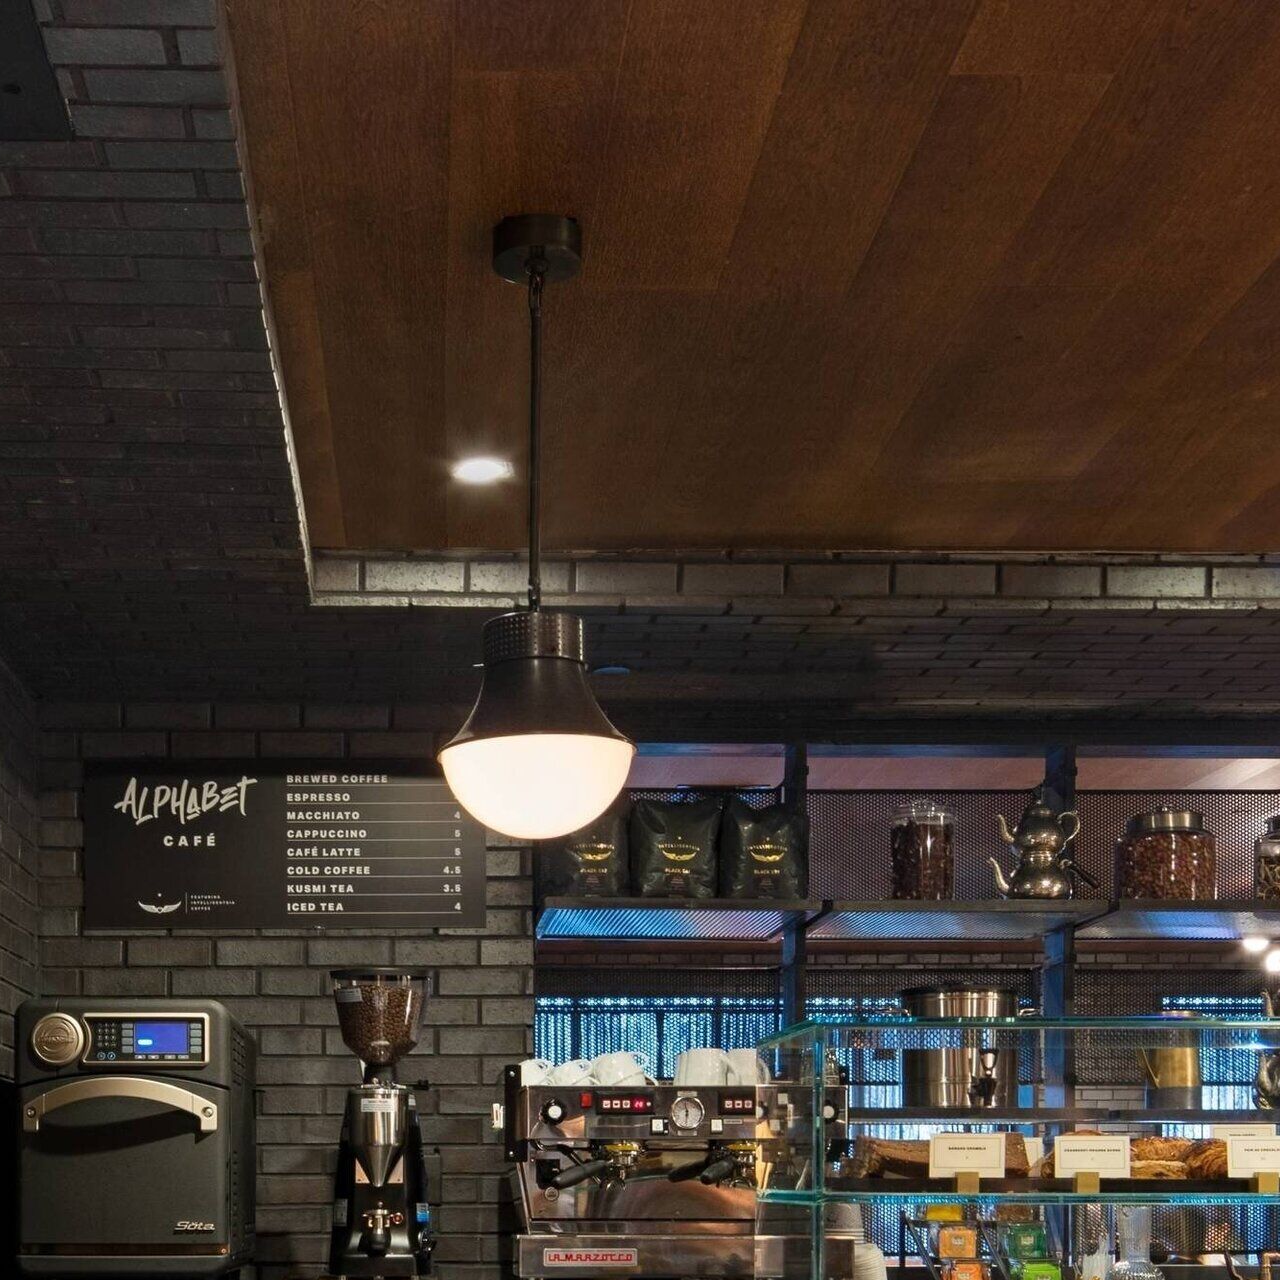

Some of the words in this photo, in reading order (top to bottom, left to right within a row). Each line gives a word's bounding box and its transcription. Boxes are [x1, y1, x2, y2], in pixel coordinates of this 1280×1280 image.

[286, 775, 337, 783] BREWED
[342, 775, 388, 783] COFFEE
[114, 776, 258, 825] ALPHABET
[286, 793, 351, 801] ESPRESSO
[286, 811, 360, 820] MACCHIATO
[454, 811, 461, 819] 4
[286, 829, 367, 838] CAPPUCCINO
[454, 829, 461, 838] 5
[163, 833, 216, 847] CAFÉ
[286, 846, 318, 857] CAFÉ
[322, 848, 361, 857] LATTE
[286, 866, 320, 875] COLD
[323, 866, 370, 875] COFFEE
[443, 866, 461, 874] 4.5
[287, 884, 326, 893] KUSMI
[330, 884, 354, 893] TEA
[443, 884, 461, 892] 3.5
[287, 903, 316, 911] ICED
[320, 903, 344, 911] TEA
[454, 902, 461, 911] 4
